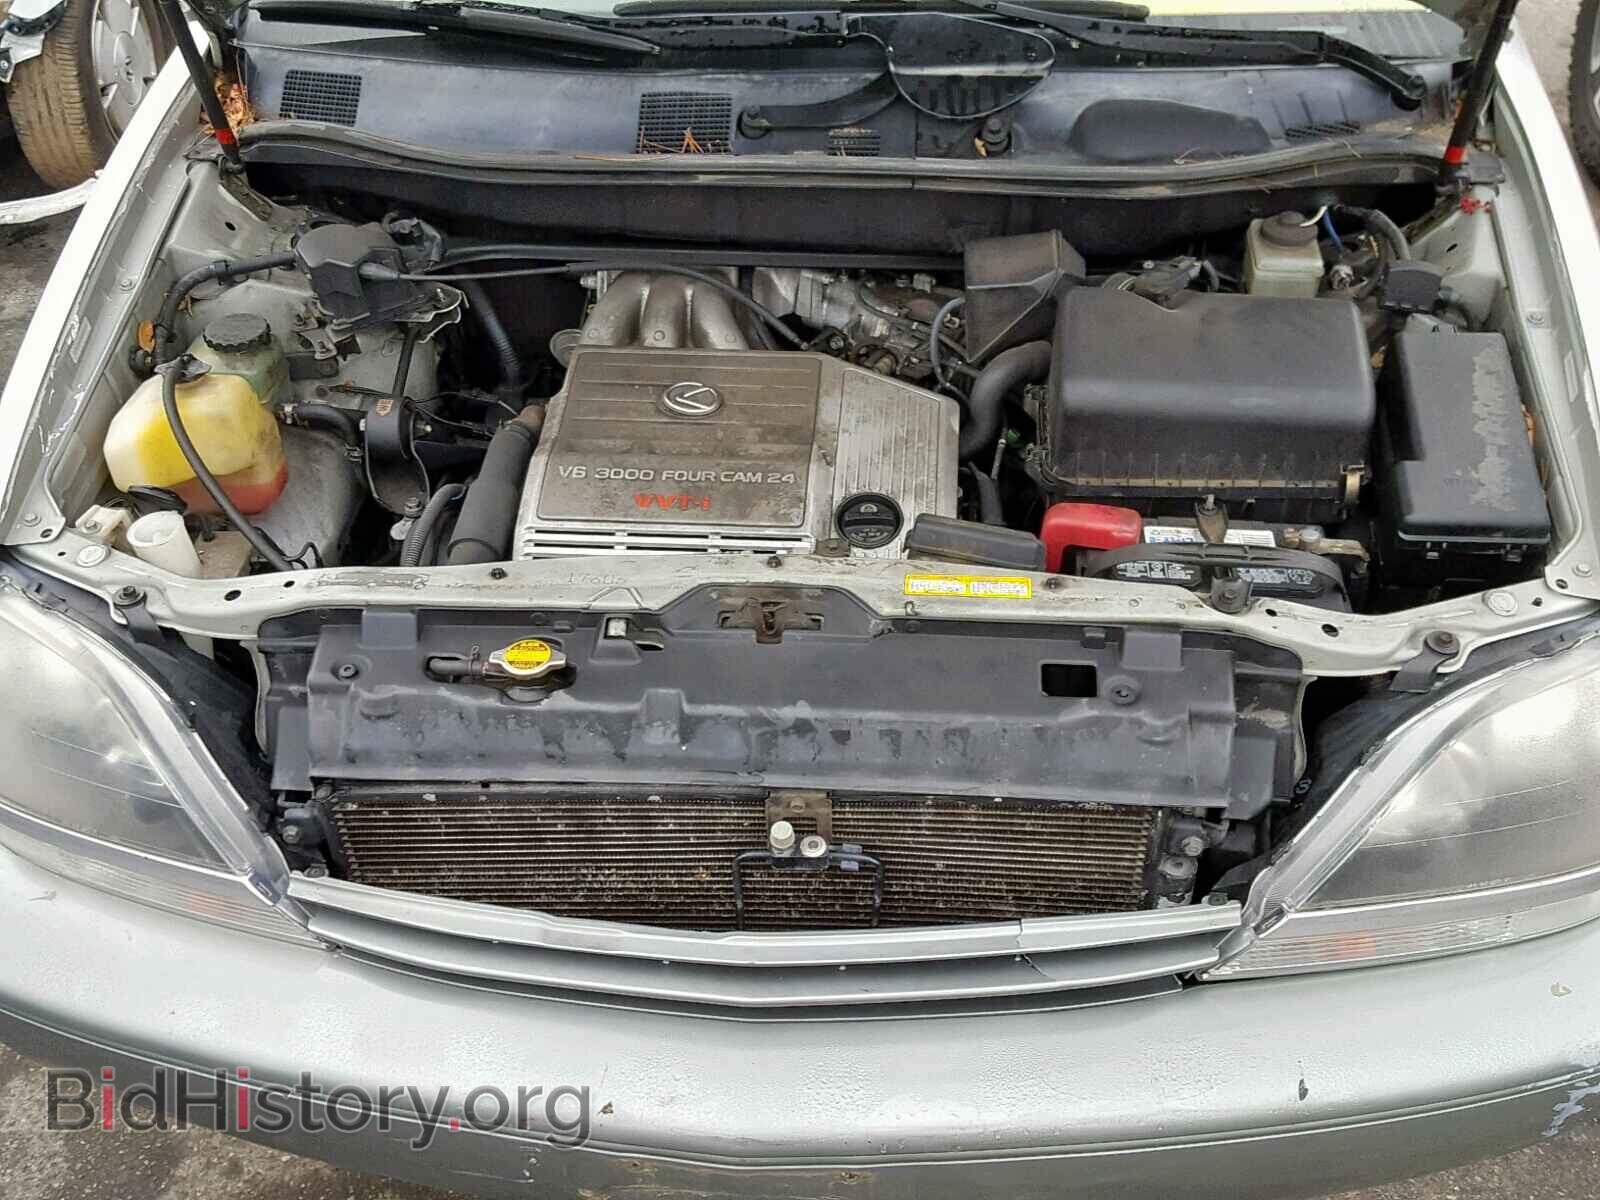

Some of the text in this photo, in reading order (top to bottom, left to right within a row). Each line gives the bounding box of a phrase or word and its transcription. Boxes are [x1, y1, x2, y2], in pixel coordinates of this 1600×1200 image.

[559, 465, 795, 484] V6 3000 FOUR CAM 24
